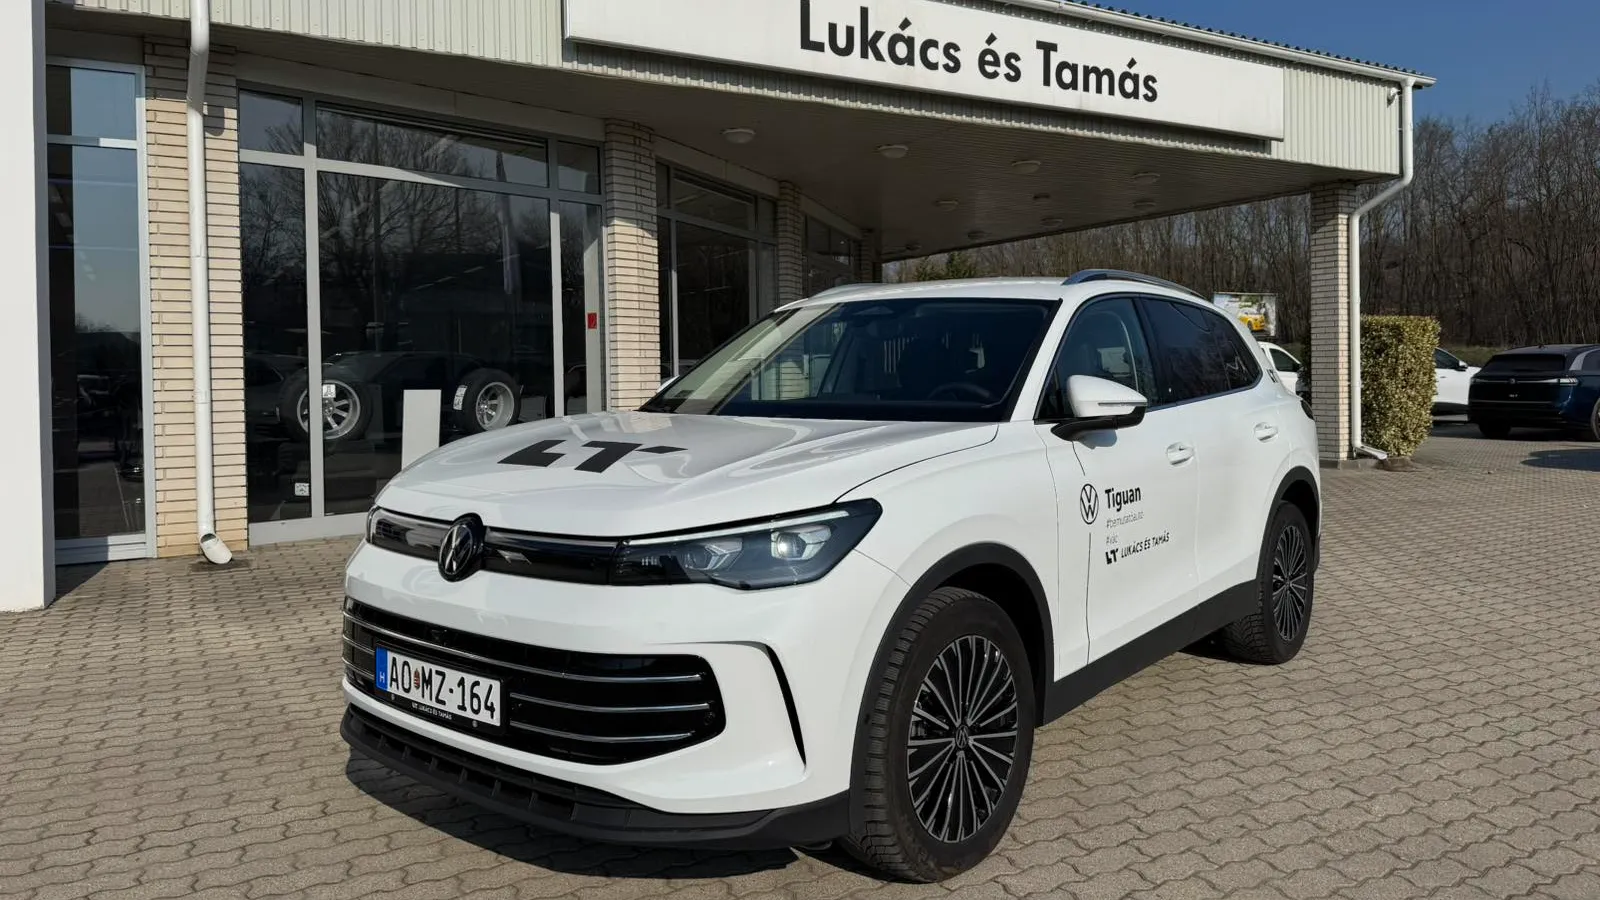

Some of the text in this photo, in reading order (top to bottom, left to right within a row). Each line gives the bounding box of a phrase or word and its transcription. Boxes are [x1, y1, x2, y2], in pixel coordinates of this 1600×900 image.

[800, 0, 1158, 103] Lukács és Tamás
[1105, 487, 1141, 512] Tiguan
[1121, 541, 1143, 558] LUKÁCS
[1144, 535, 1151, 550] ÉS
[1152, 530, 1170, 547] TAMÁS
[379, 672, 386, 684] H
